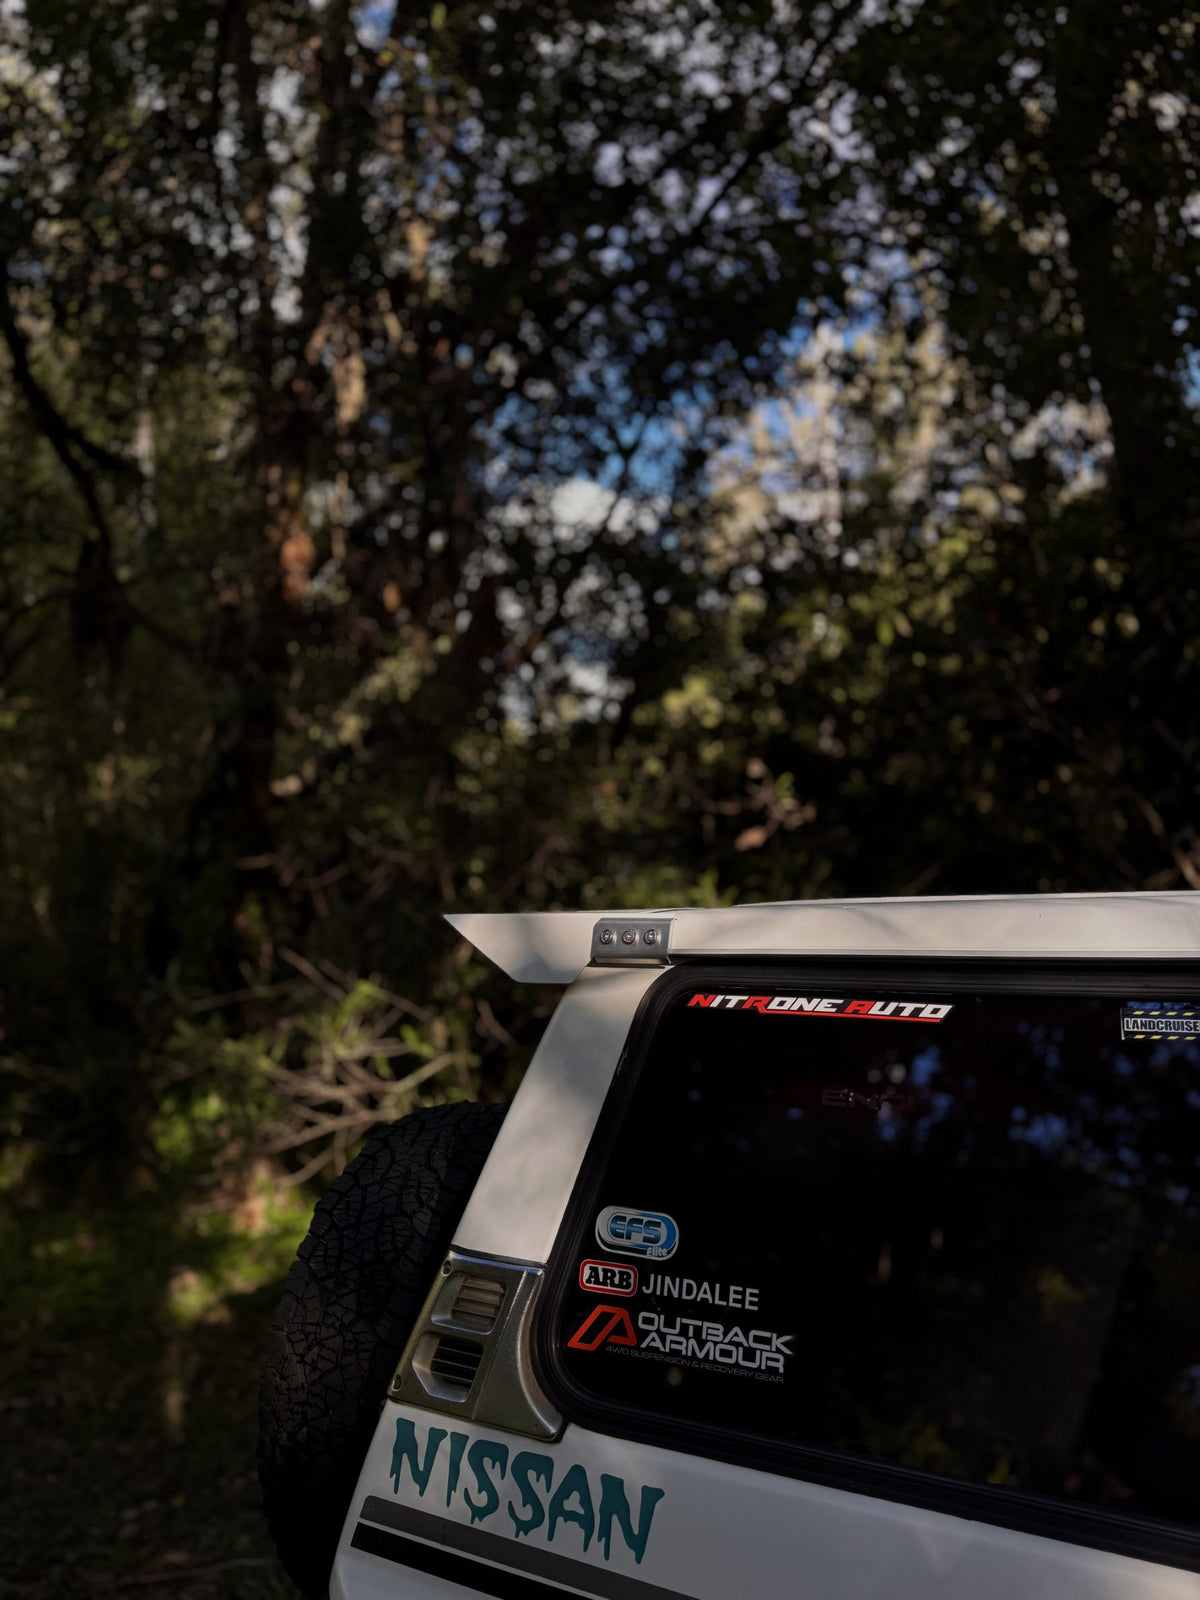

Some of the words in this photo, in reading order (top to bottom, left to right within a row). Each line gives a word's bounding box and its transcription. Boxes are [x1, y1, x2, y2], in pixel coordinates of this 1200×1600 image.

[687, 994, 844, 1013] NITRONE
[844, 999, 952, 1019] AUTO
[609, 1215, 662, 1244] EFS
[585, 1266, 633, 1290] ARB
[642, 1274, 760, 1311] JINDALEE
[638, 1311, 795, 1355] OUTBACK
[640, 1332, 785, 1373] ARMOUR
[605, 1345, 630, 1356] 4WD
[630, 1350, 691, 1367] SUSPENSION
[700, 1363, 754, 1379] RECOVERY
[755, 1373, 785, 1385] GEAR
[389, 1417, 665, 1565] NISSAN
